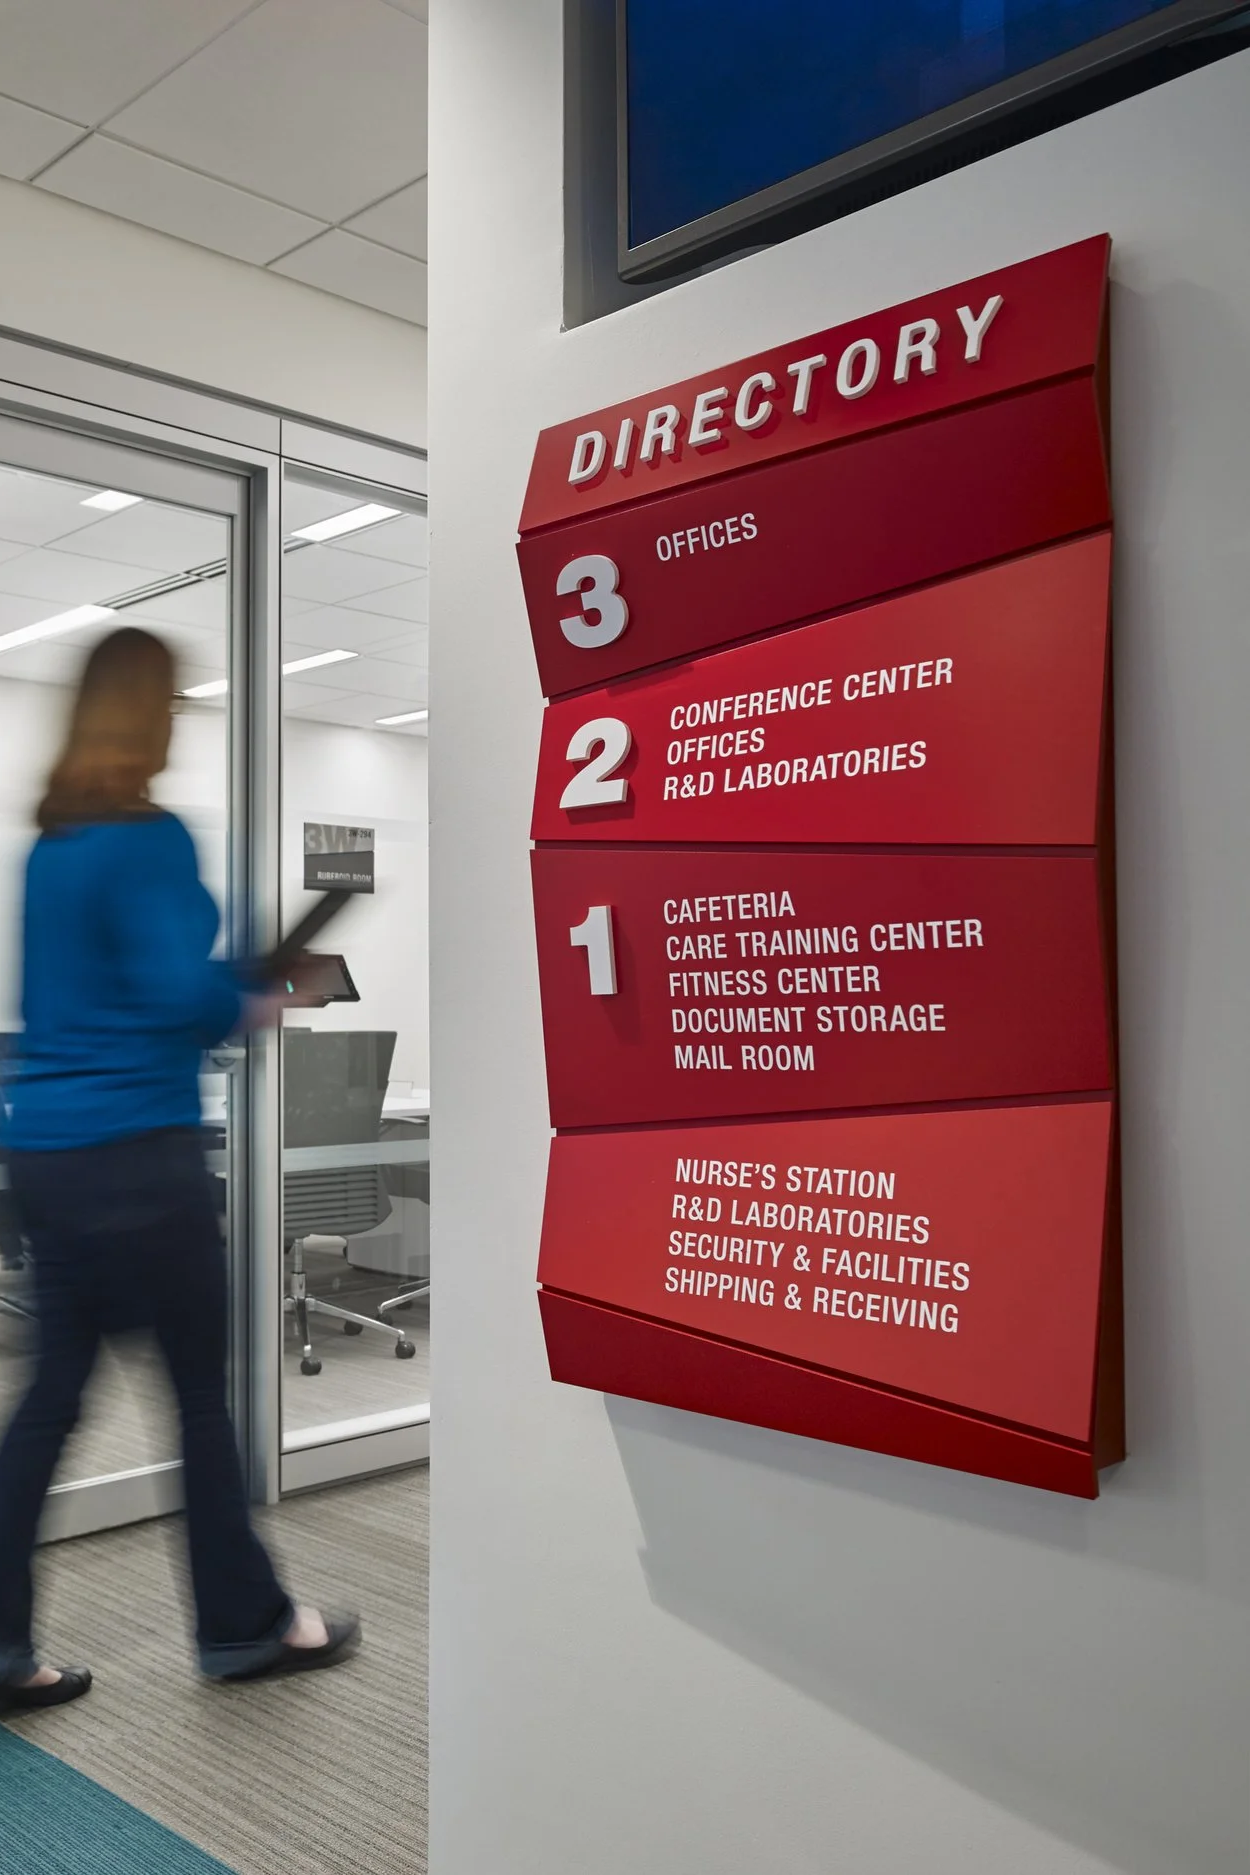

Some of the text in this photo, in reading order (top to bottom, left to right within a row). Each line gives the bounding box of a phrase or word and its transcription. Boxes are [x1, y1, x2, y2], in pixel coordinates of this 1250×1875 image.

[568, 295, 1005, 484] DIRECTORY
[656, 513, 758, 562] OFFICES
[556, 554, 629, 649] 3
[670, 658, 953, 730] CONFERENCE CENTER
[559, 717, 632, 809] 2
[663, 741, 927, 801] R&D LABORATORIES
[667, 728, 765, 765] OFFICES
[352, 873, 372, 882] ROOM
[663, 891, 796, 925] CAFETERIA
[569, 905, 618, 996] 1
[666, 919, 983, 961] CARE TRAINING CENTER
[669, 966, 881, 997] FITNESS CENTER
[672, 1004, 947, 1033] DOCUMENT STORAGE
[674, 1044, 816, 1072] MAIL ROOM
[675, 1158, 897, 1200] NURSE'S STATION
[672, 1195, 931, 1245] R&D LABORATORIES
[668, 1230, 970, 1292] SECURITY & FACILITIES
[664, 1266, 959, 1333] SHIPPING & RECEIVING
